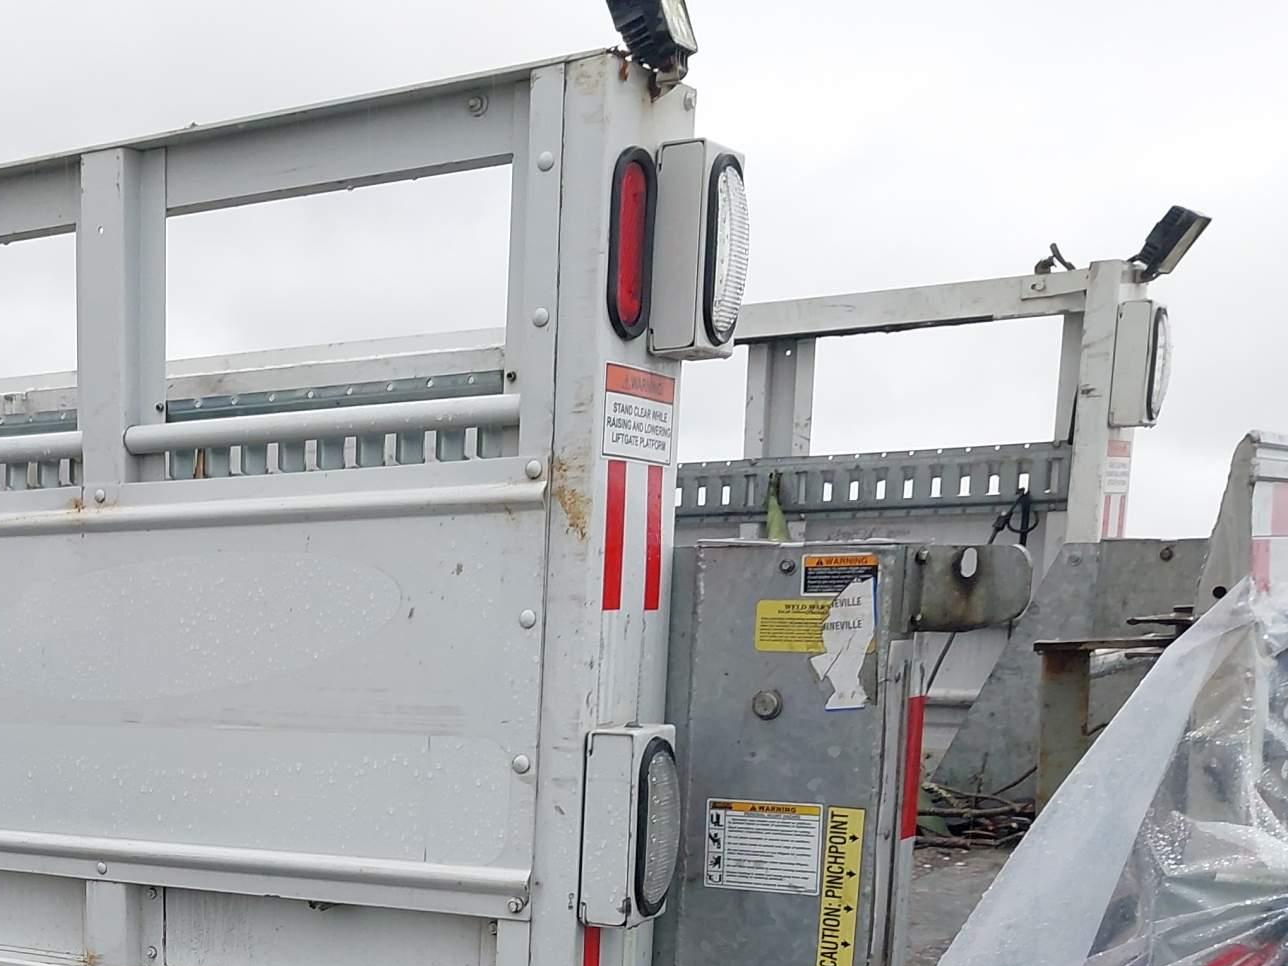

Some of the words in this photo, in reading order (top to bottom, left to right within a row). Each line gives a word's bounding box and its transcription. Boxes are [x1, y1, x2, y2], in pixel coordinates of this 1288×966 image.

[613, 402, 633, 416] STAND
[634, 406, 651, 420] CLEAR
[652, 411, 668, 423] WHILE
[606, 416, 632, 430] RAISING
[632, 421, 644, 433] AND
[644, 424, 671, 438] LOWERING
[611, 432, 639, 447] LIFTGATE
[639, 437, 666, 451] PLATFORM
[825, 556, 868, 565] WARNING
[758, 805, 797, 813] WARNING
[825, 810, 849, 899] PINCHPOINT
